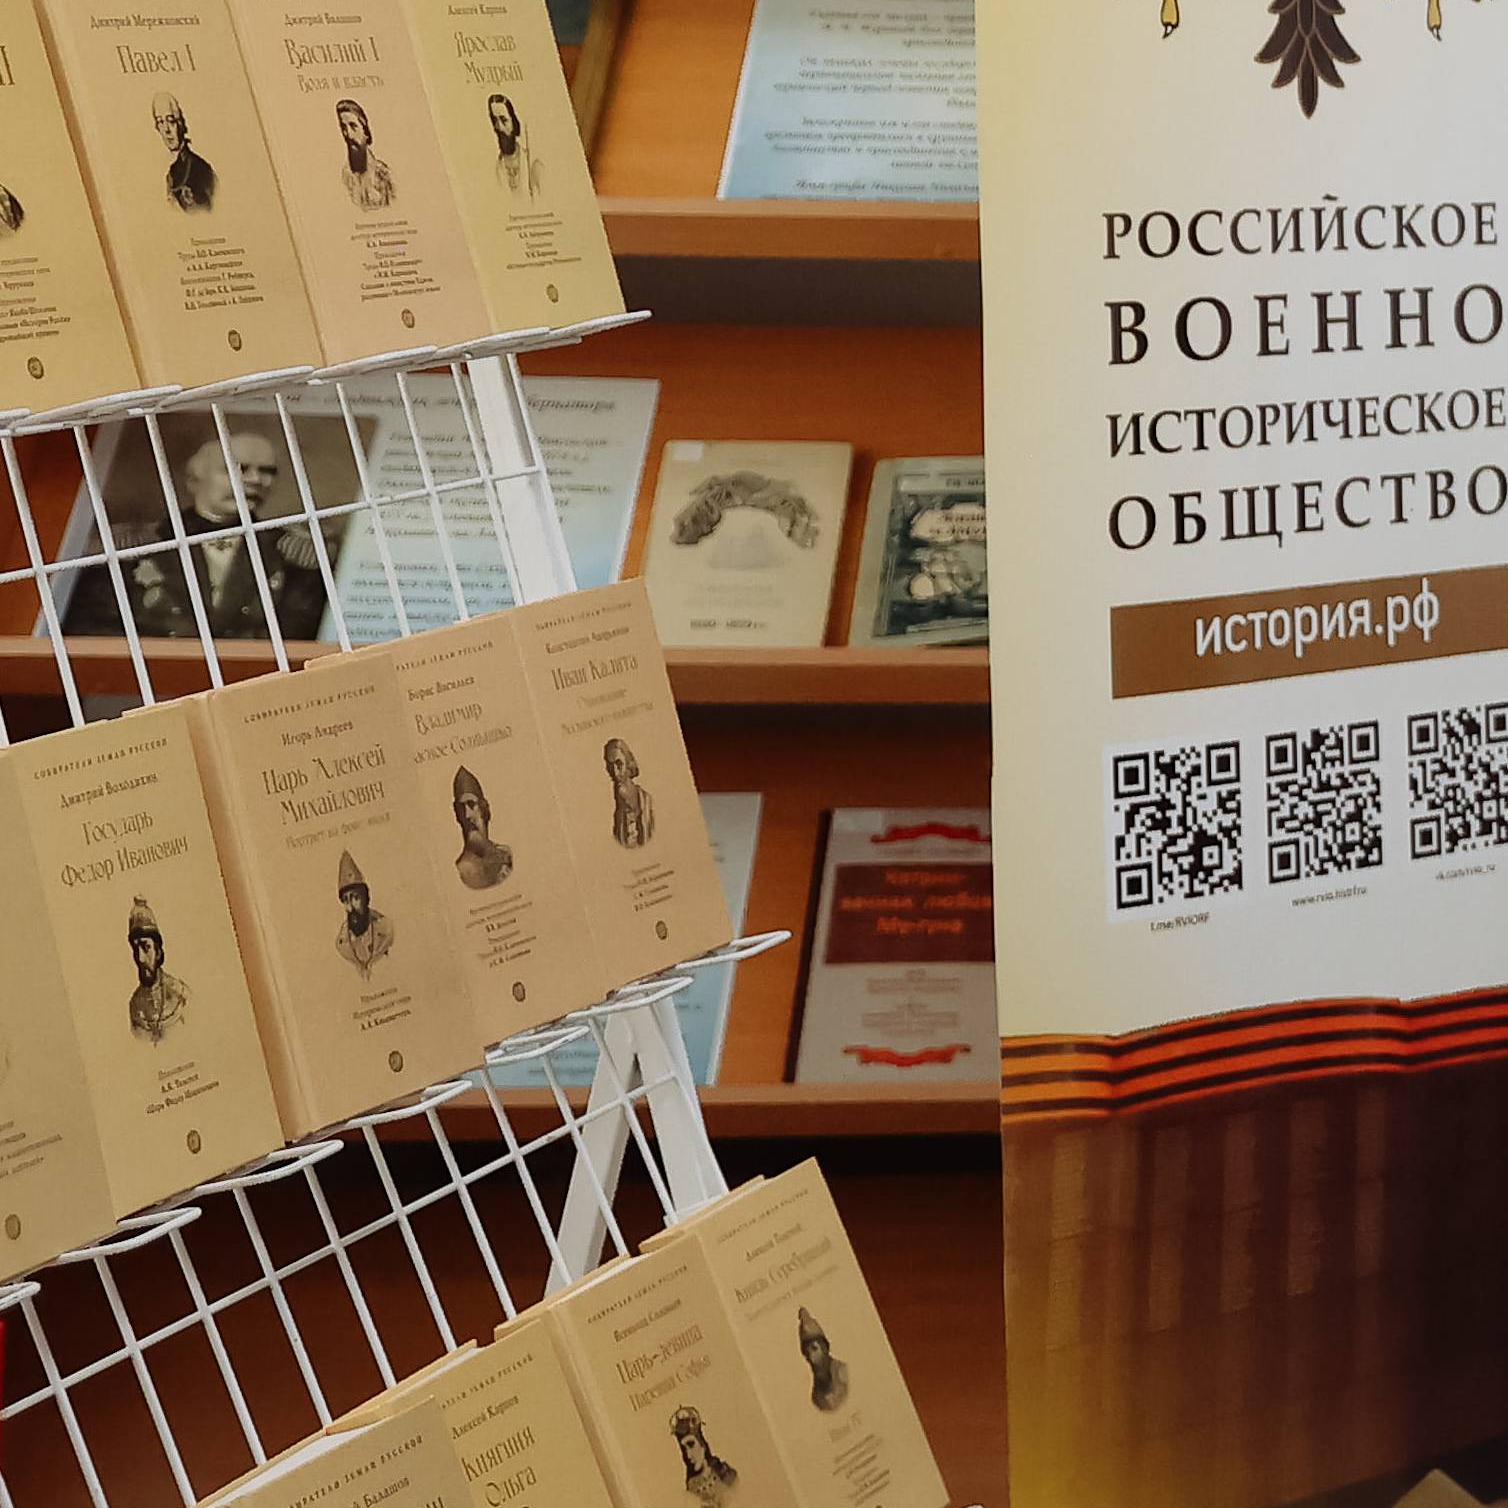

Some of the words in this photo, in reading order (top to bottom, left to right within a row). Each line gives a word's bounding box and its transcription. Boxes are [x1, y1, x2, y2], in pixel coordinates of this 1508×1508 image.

[116, 44, 183, 74] Павел
[185, 43, 197, 72] I
[284, 37, 367, 69] Василий
[368, 36, 380, 62] I
[454, 30, 517, 59] Ярослав
[464, 60, 524, 89] Мудрый
[1102, 194, 1499, 261] РОССИЙСКОЕ
[1104, 282, 1504, 367] ВОЕННО
[1106, 387, 1508, 458] ИСТОРИЧЕСКОЕ
[1194, 576, 1441, 660] история.рф
[551, 667, 588, 691] Иван
[588, 652, 639, 681] Калита
[281, 732, 313, 747] Игорь
[314, 720, 354, 738] Андреев
[414, 703, 483, 736] Владимир
[261, 768, 309, 796] Царь
[312, 743, 387, 780] Алексей
[60, 784, 105, 810] Дмитрий
[280, 780, 386, 826] Михайлович
[82, 810, 154, 846] Государь
[60, 857, 115, 888] Федор
[116, 835, 189, 873] Иванович
[451, 1411, 487, 1441] Алексей
[460, 1424, 536, 1483] Княгиня
[485, 1465, 538, 1508] Ольга
